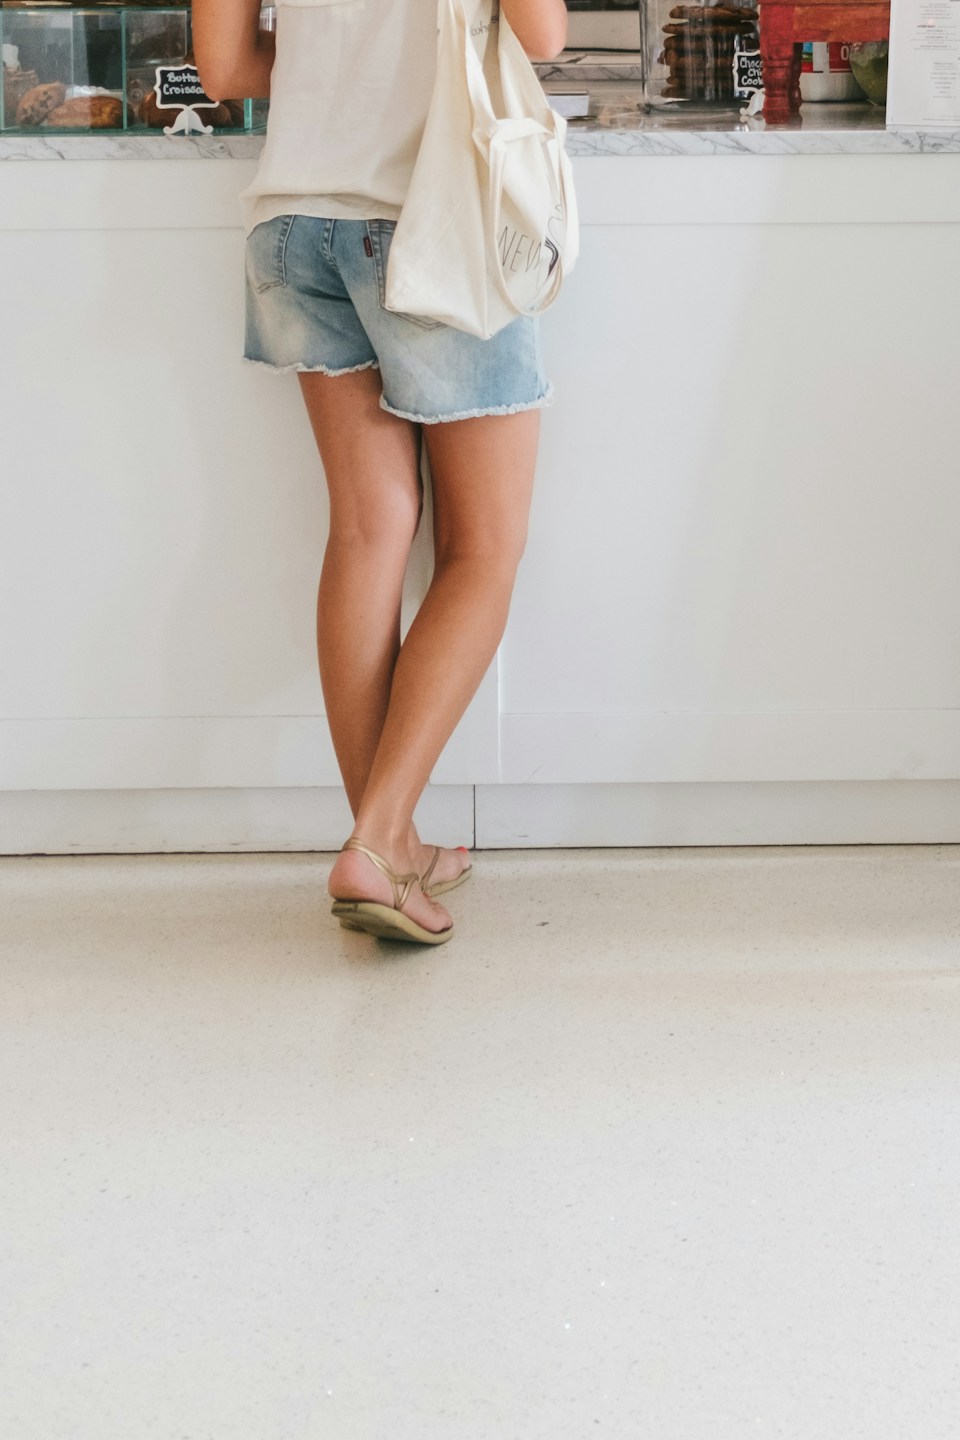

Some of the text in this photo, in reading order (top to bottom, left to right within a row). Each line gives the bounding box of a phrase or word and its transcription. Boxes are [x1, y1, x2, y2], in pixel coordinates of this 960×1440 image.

[748, 68, 762, 77] Chi
[741, 75, 764, 86] Cook
[162, 83, 205, 95] Croissa
